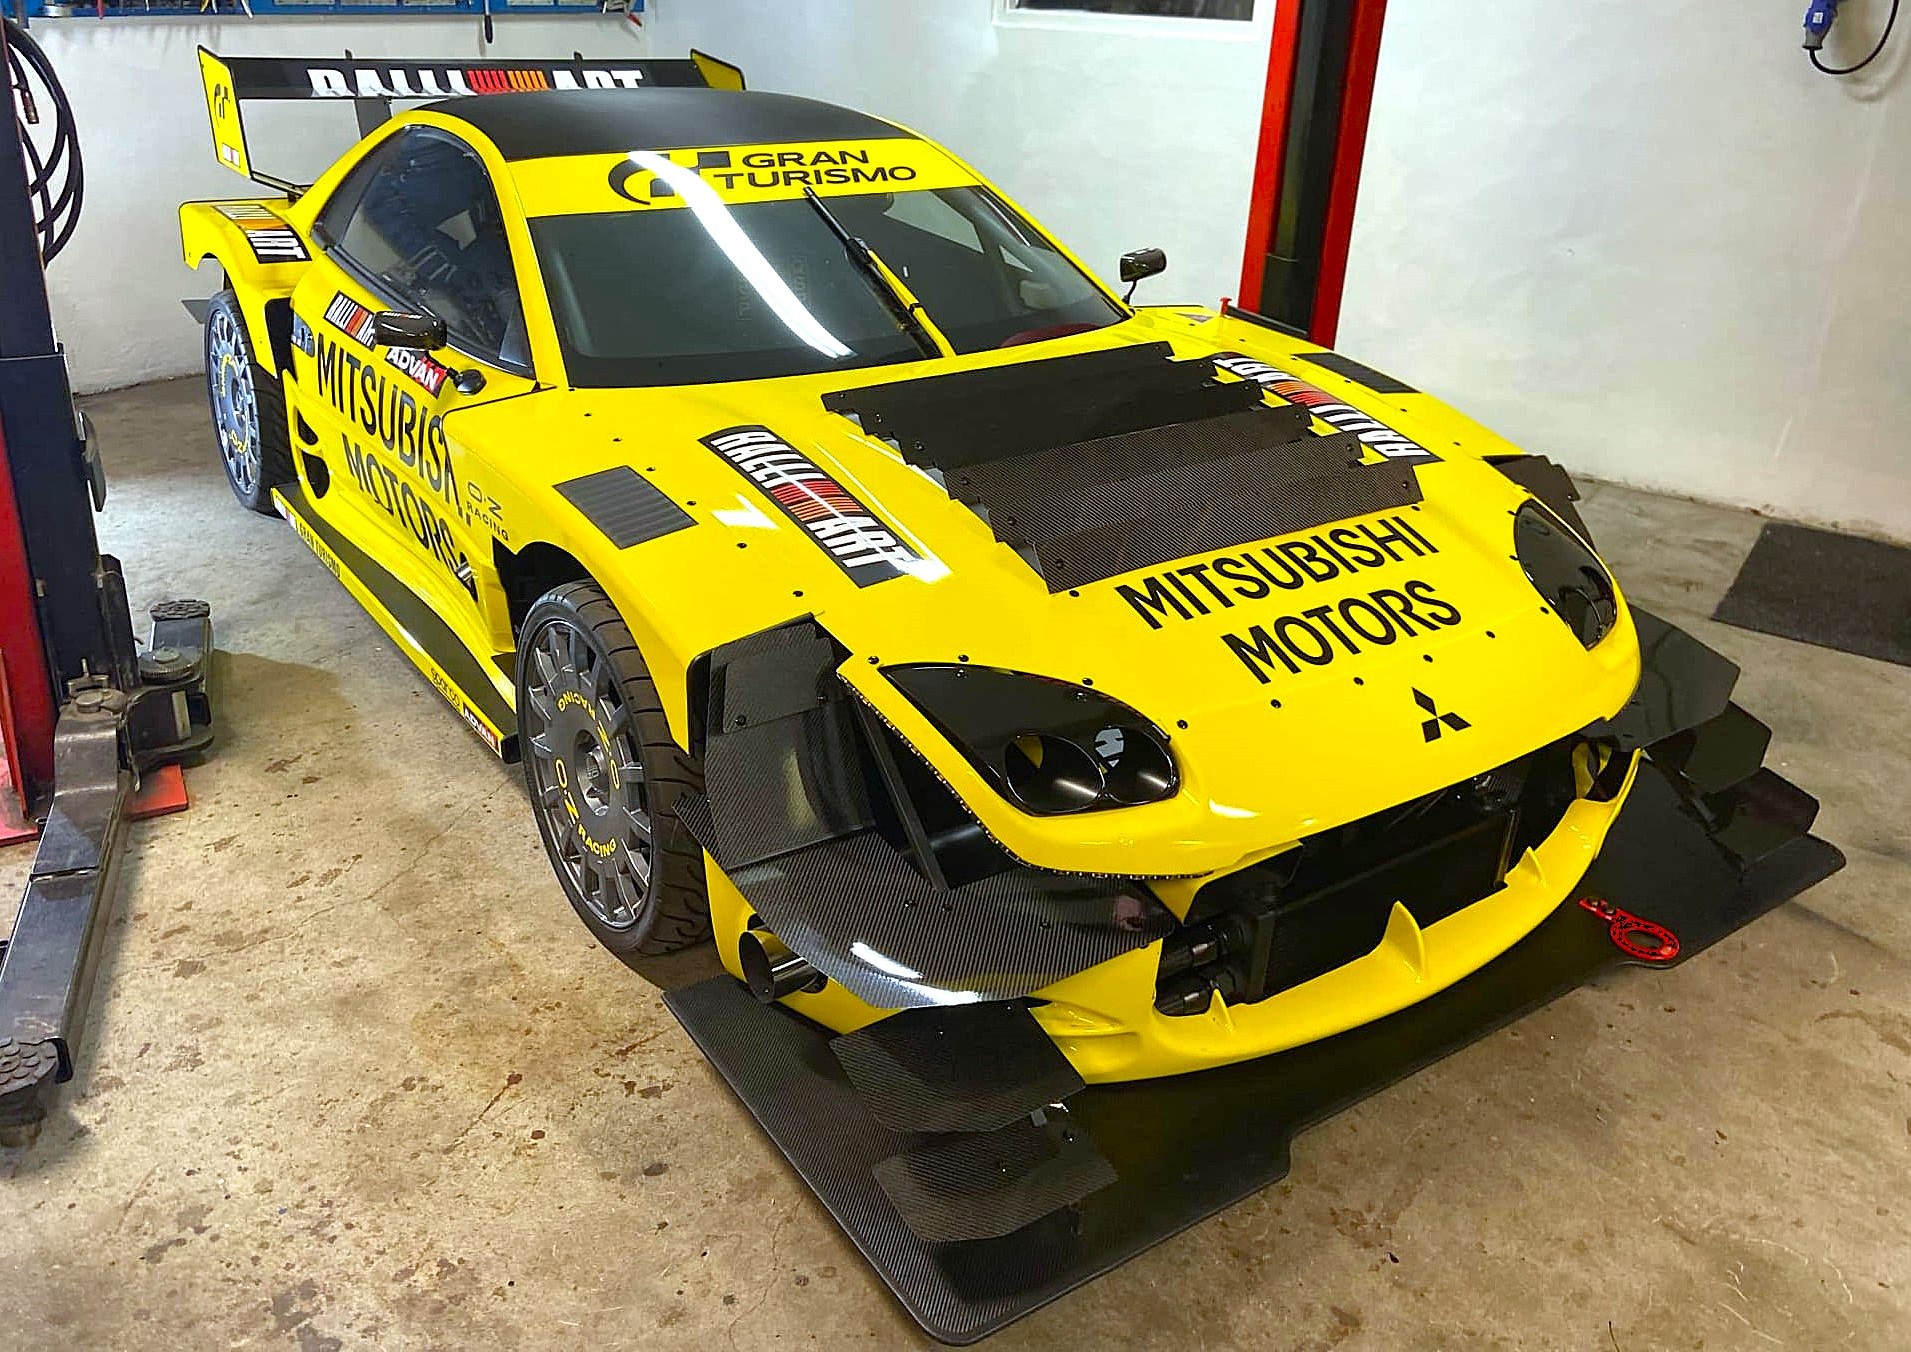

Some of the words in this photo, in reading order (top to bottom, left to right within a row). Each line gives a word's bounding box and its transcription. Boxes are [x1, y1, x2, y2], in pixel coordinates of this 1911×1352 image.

[713, 166, 916, 190] TURISMO
[742, 150, 869, 168] GRAN
[244, 229, 307, 259] ART
[386, 348, 439, 392] ADVAN
[318, 333, 472, 528] MITSUBIS
[342, 433, 459, 573] MOTORS
[710, 431, 817, 489] RALLI
[806, 516, 914, 568] ART
[466, 501, 509, 541] RACING
[1114, 516, 1440, 630] MITSUBISHI
[1220, 580, 1462, 685] MOTORS
[557, 690, 596, 720] RACING
[578, 823, 617, 857] RACING
